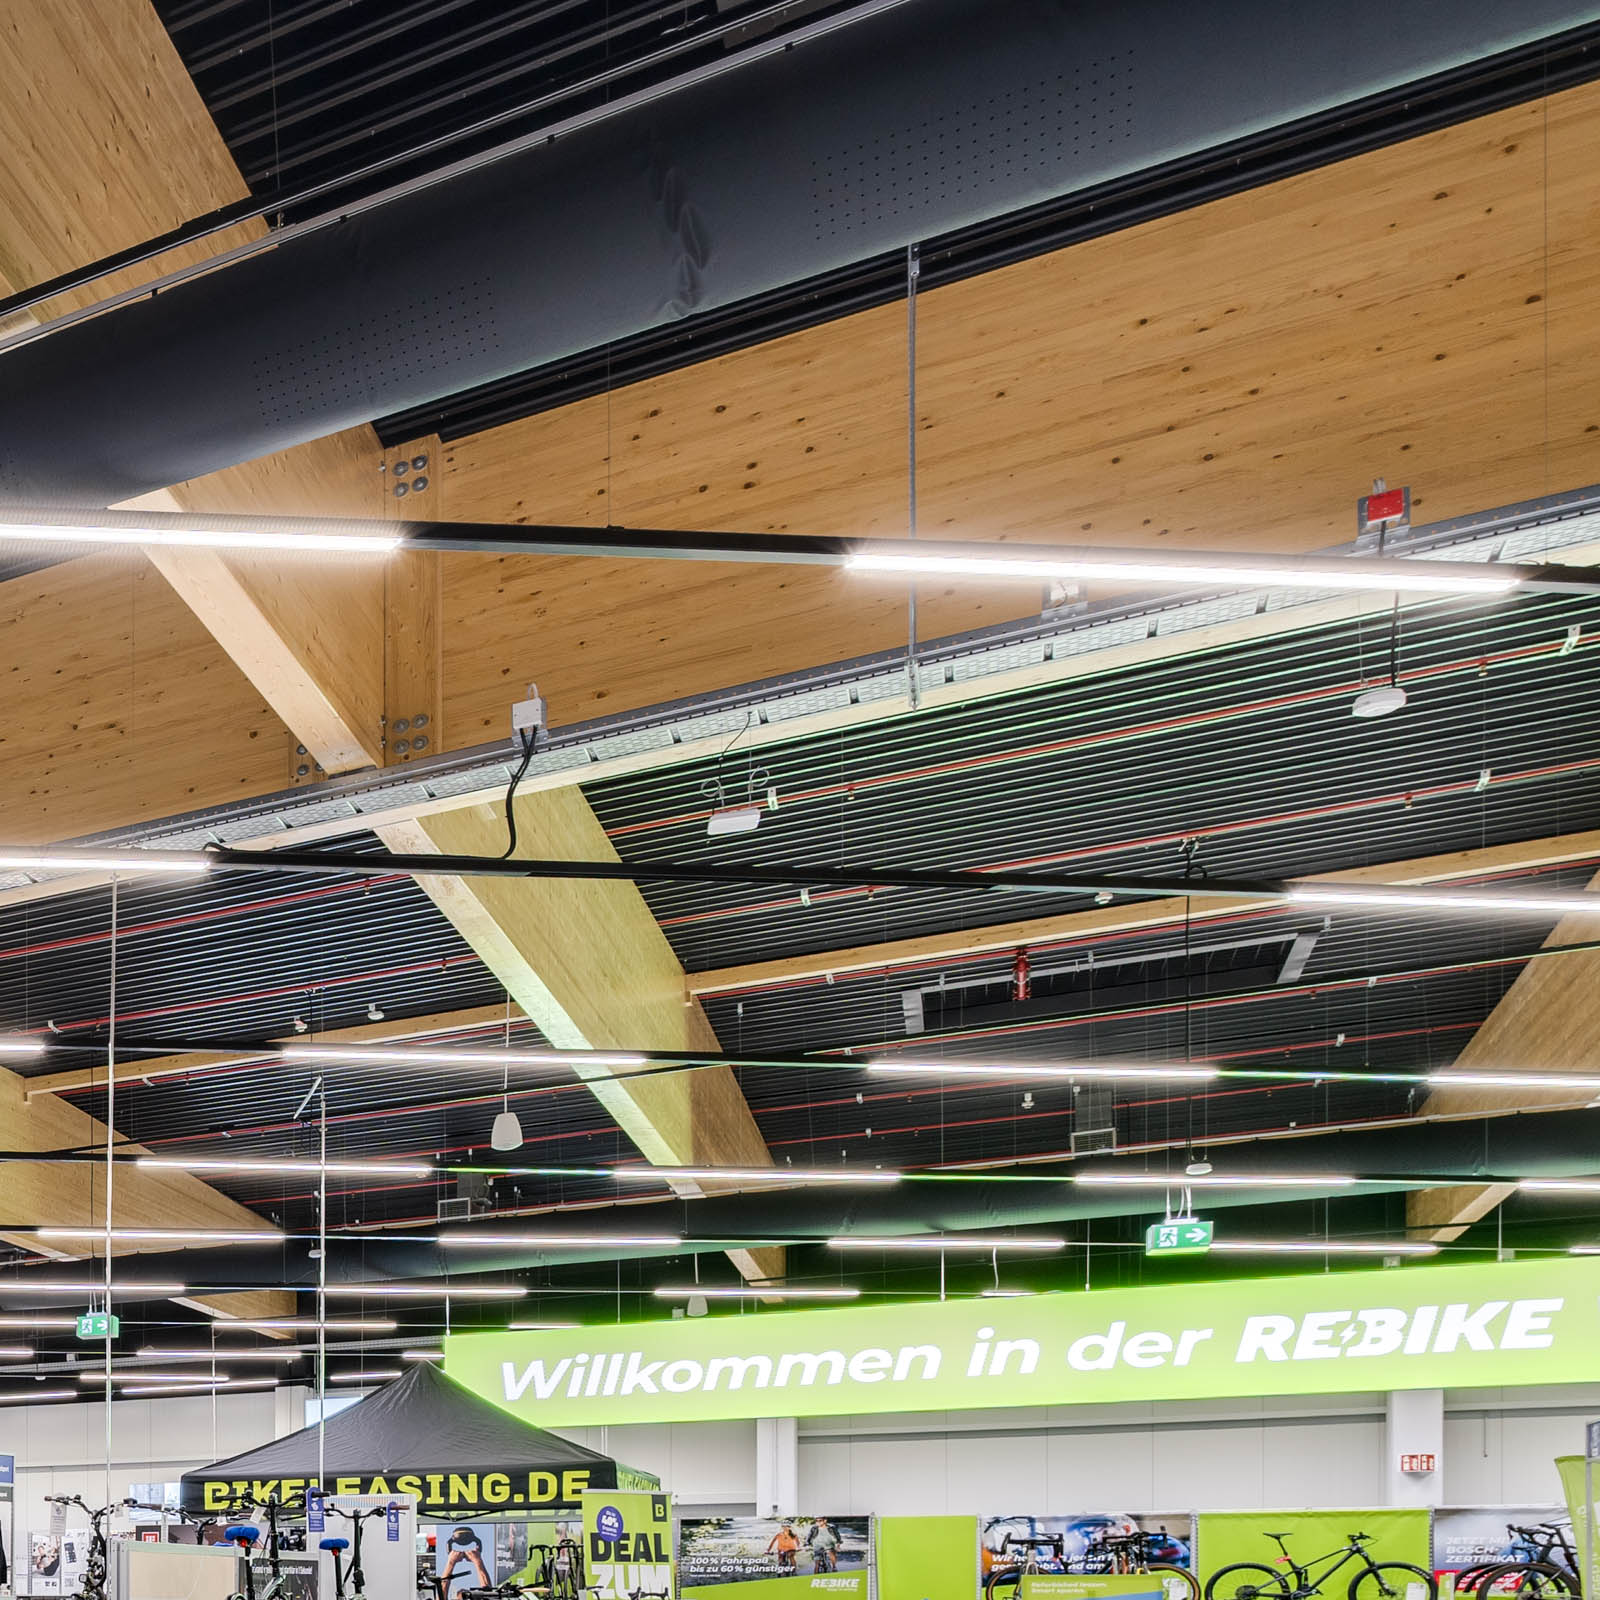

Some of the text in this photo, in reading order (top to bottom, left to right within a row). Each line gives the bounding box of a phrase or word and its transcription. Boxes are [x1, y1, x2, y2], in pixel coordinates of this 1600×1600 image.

[502, 1297, 1564, 1401] Willkommen in der REBIKE
[590, 1533, 669, 1562] DEAL
[1446, 1545, 1499, 1554] BOSCH-
[720, 1556, 769, 1566] Fahrspaß
[1445, 1554, 1524, 1563] ZERTIFIKAT
[690, 1565, 705, 1573] bis
[745, 1564, 796, 1575] günstiger
[591, 1564, 672, 1600] ZUM
[811, 1578, 860, 1588] REBIKE
